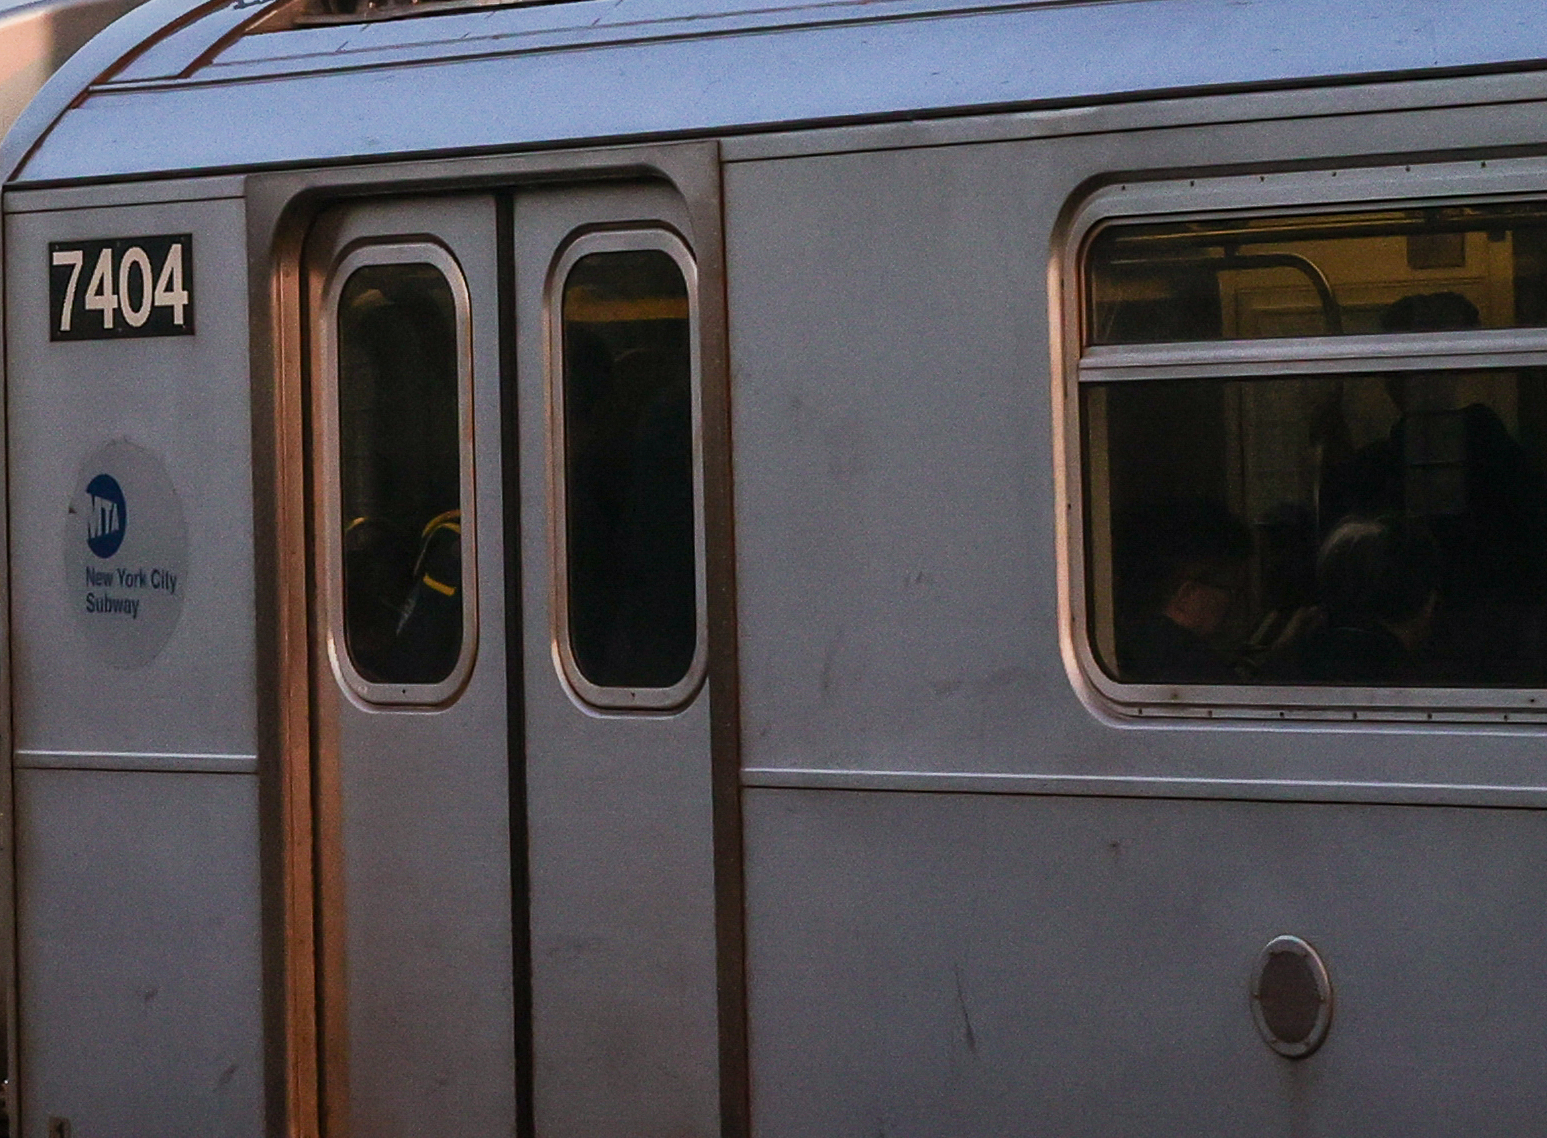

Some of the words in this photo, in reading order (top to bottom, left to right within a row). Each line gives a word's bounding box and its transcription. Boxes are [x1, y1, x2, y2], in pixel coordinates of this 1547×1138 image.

[52, 244, 189, 331] 7404
[86, 566, 113, 587] New
[117, 568, 147, 588] York
[151, 568, 177, 595] City
[86, 592, 140, 620] Subway
